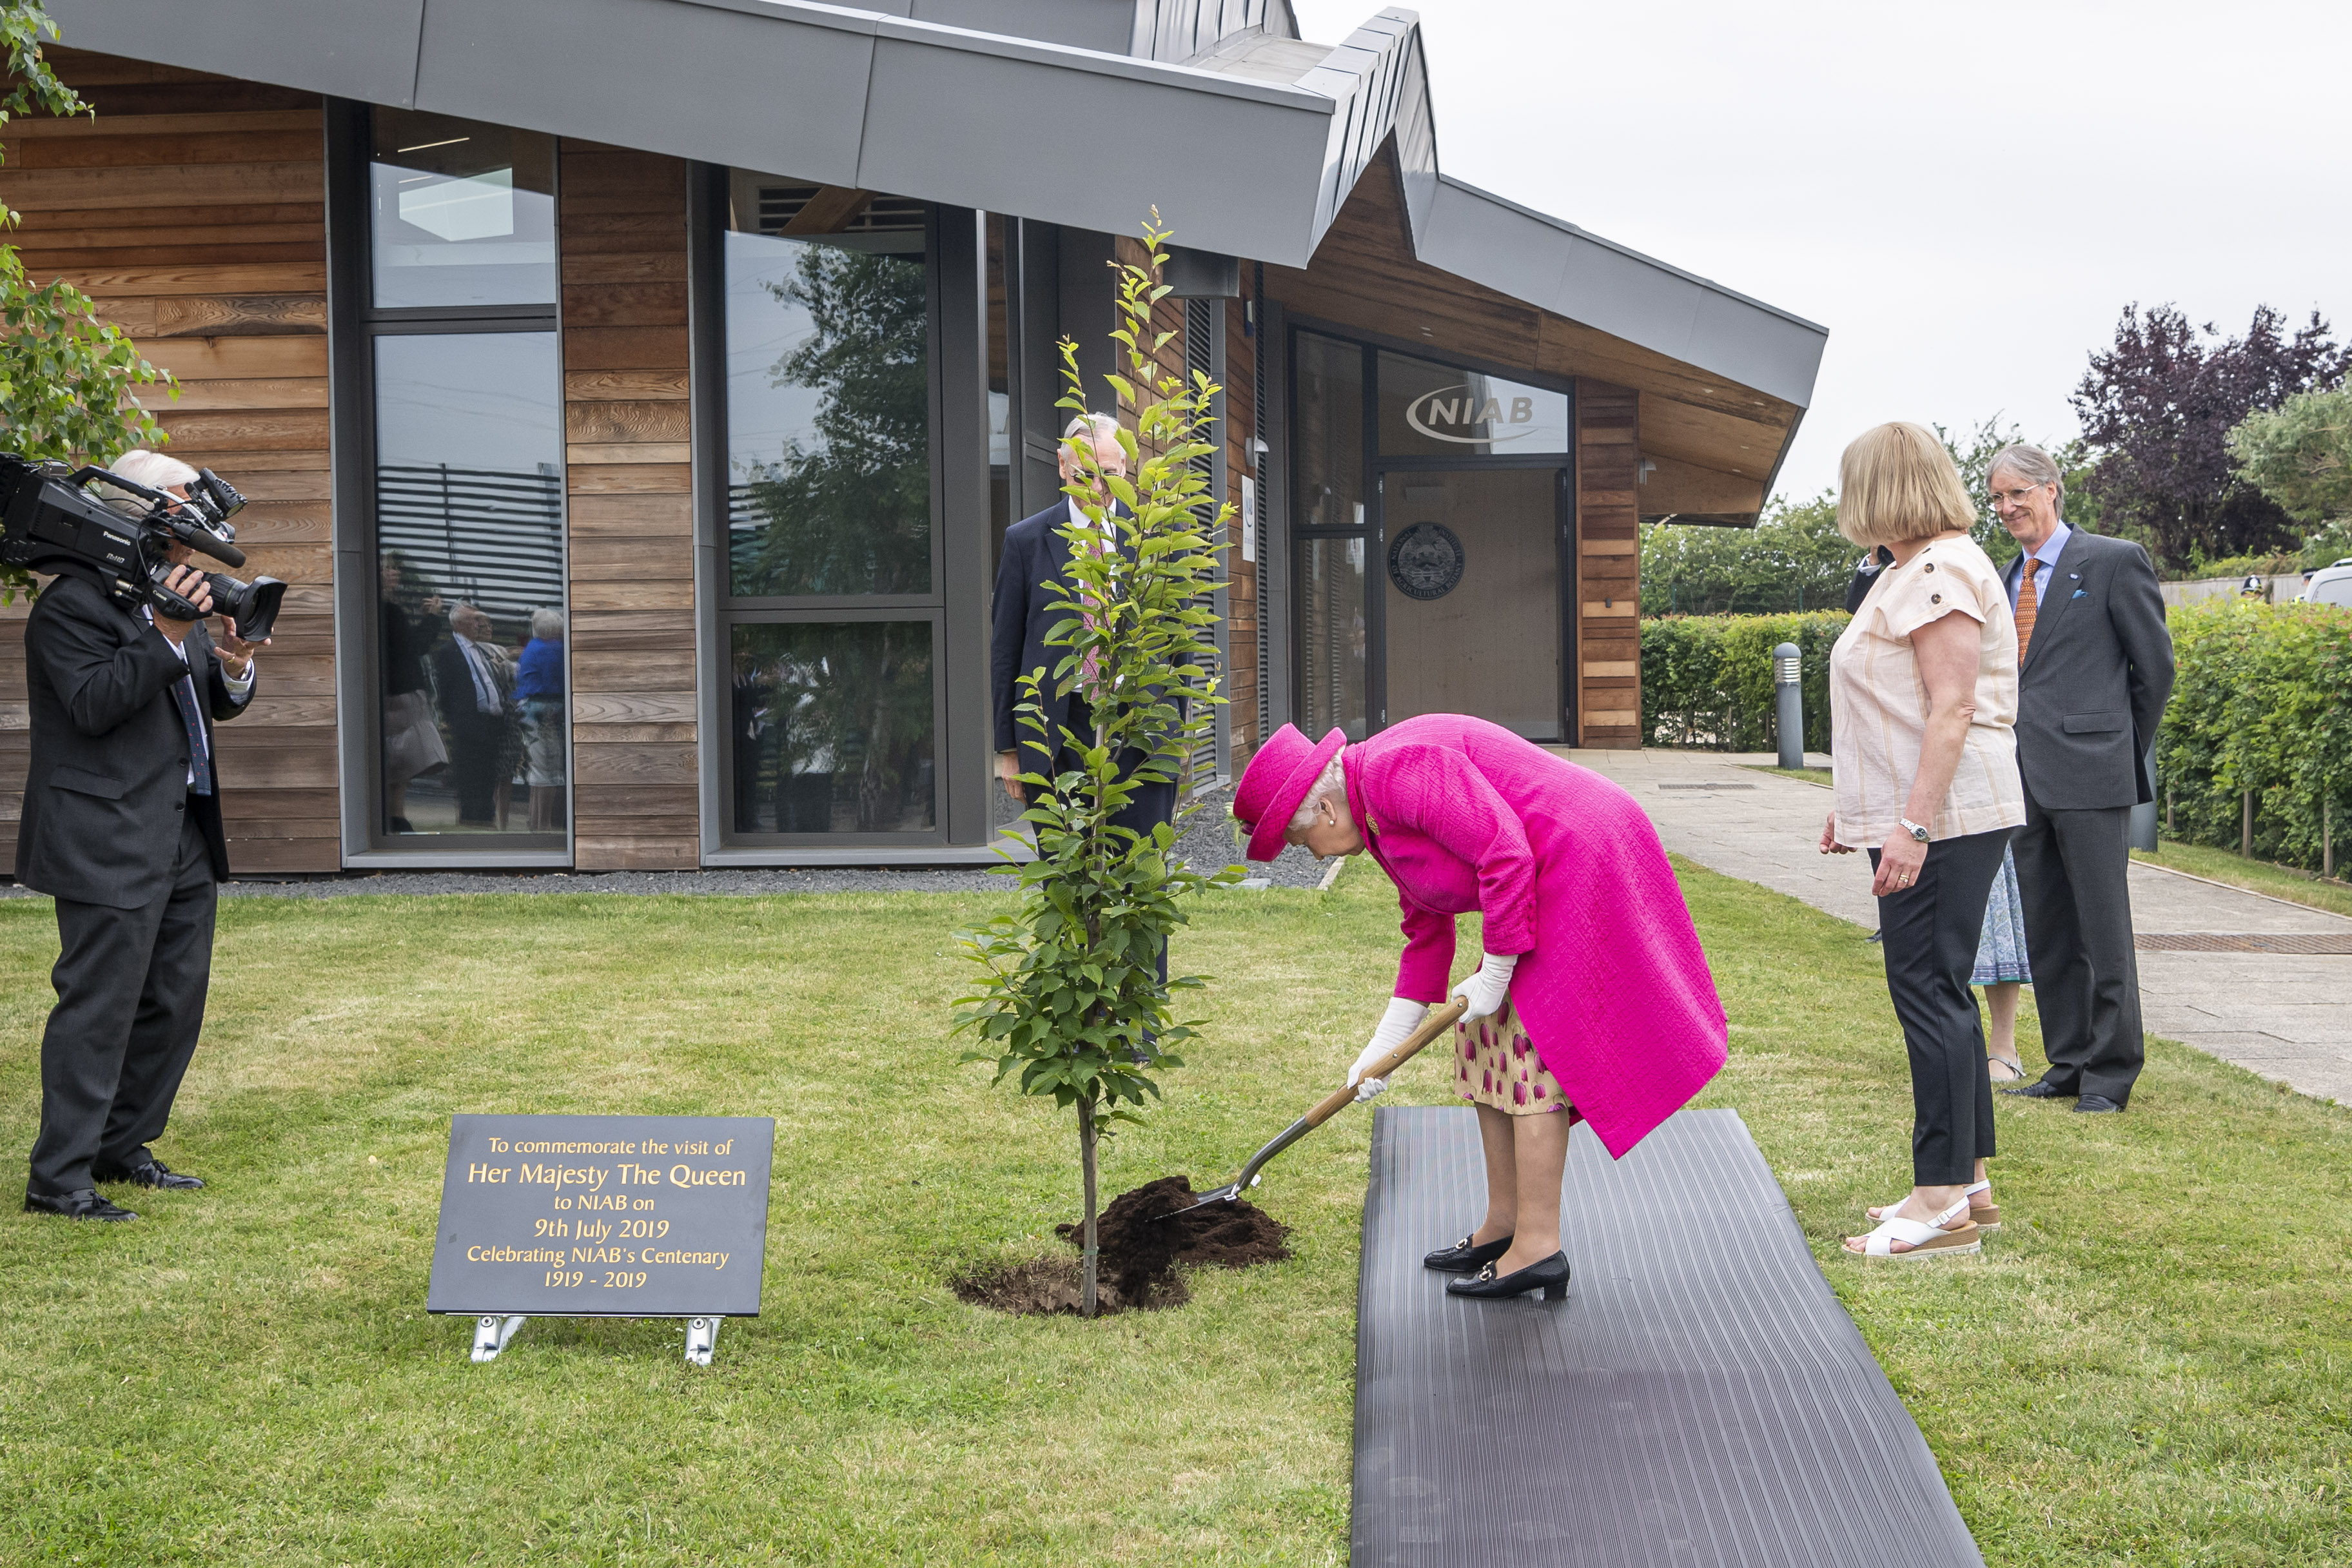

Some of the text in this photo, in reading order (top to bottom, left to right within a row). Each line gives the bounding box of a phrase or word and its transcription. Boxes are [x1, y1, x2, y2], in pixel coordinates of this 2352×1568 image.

[1428, 397, 1533, 425] NIAB
[103, 531, 131, 546] Panasonic
[1396, 576, 1446, 596] AGRICULTURAL
[1444, 563, 1462, 589] BOTANY
[489, 1137, 734, 1155] To commemorate the visit of
[467, 1162, 746, 1192] Her Majesty The Queen
[554, 1195, 655, 1211] to NIAB on
[534, 1218, 671, 1245] 9th July 2019
[467, 1245, 730, 1271] Celebrating NIAB's Centenary
[545, 1270, 583, 1288] 1919
[603, 1271, 647, 1288] 2019
